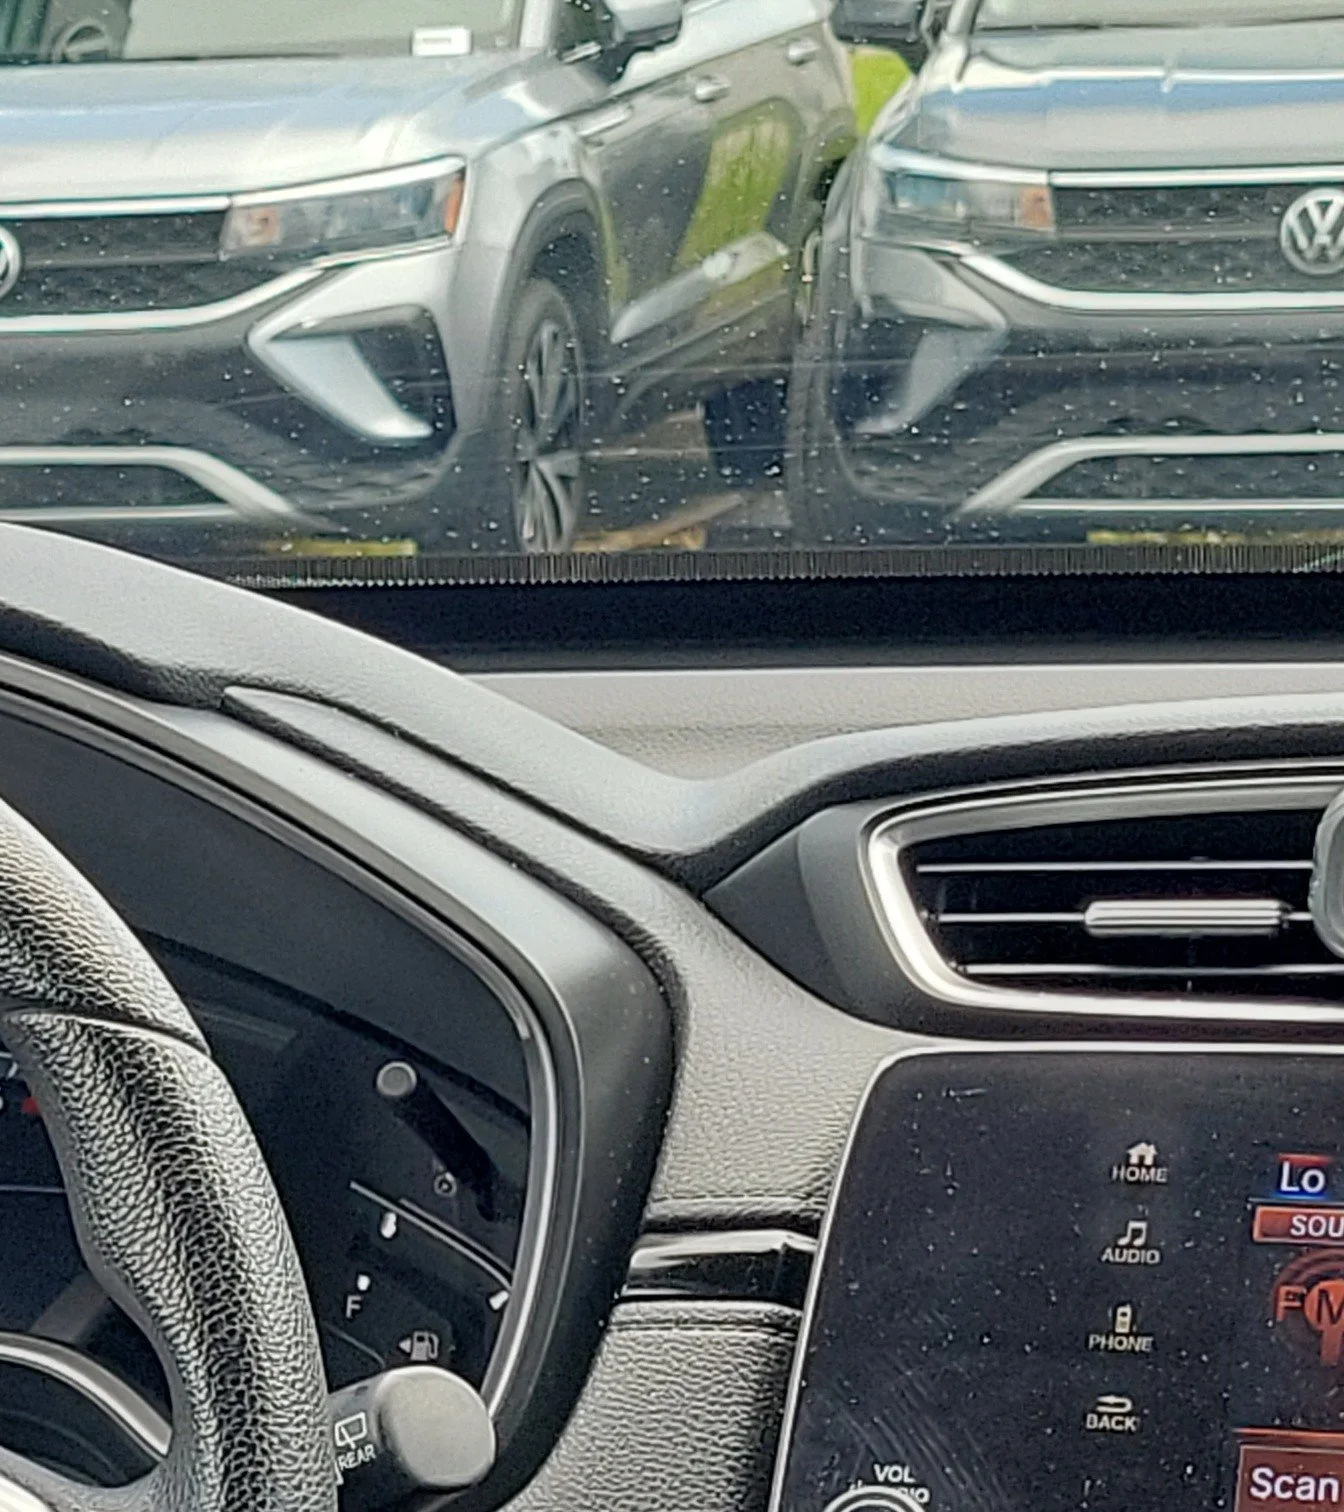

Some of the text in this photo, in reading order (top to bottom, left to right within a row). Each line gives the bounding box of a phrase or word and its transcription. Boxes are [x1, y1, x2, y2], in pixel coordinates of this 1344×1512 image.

[1112, 1165, 1167, 1183] HOME
[1280, 1161, 1326, 1194] Lo
[1290, 1214, 1344, 1238] SOU
[1101, 1248, 1161, 1265] AUDIO
[346, 1295, 363, 1318] F
[1088, 1334, 1153, 1353] PHONE
[1086, 1413, 1137, 1432] BACK
[338, 1443, 376, 1471] REAR
[873, 1464, 916, 1483] VOL
[1249, 1465, 1339, 1503] Scan
